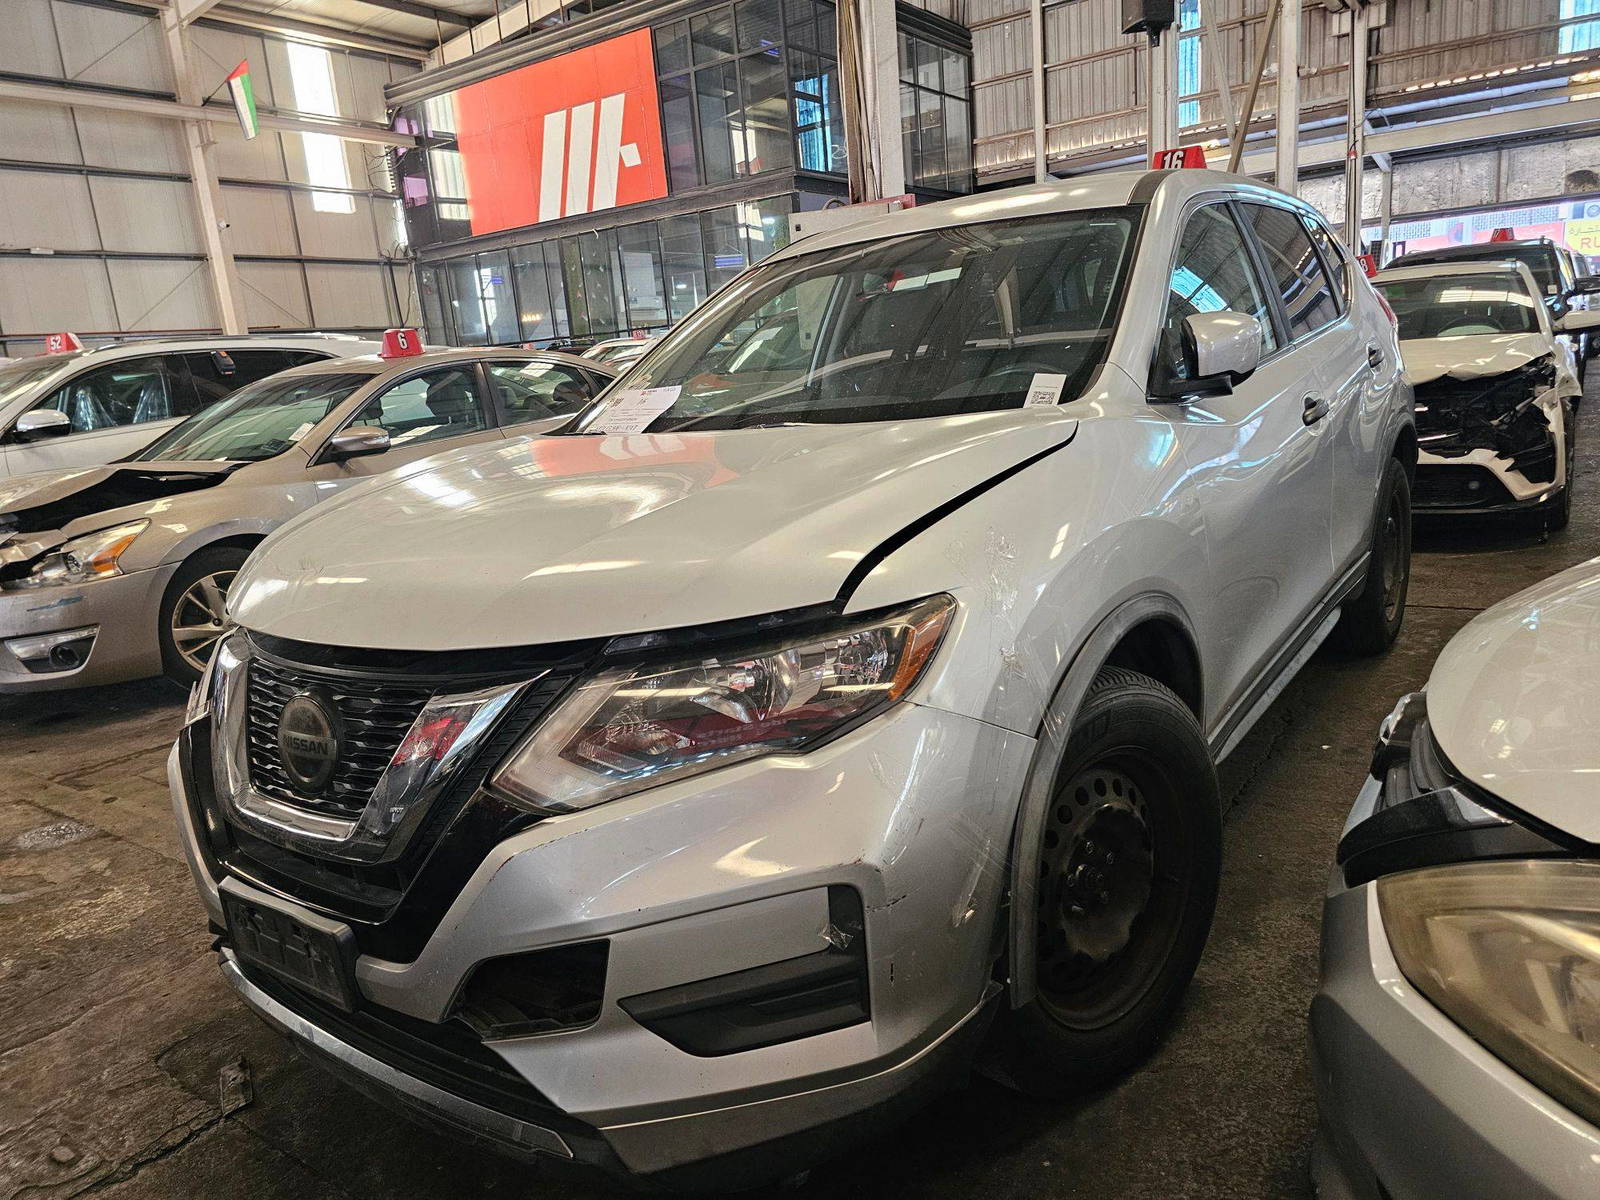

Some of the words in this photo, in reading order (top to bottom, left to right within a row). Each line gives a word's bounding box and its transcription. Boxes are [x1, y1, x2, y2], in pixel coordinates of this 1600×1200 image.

[1163, 151, 1184, 169] 16
[50, 335, 62, 350] 52
[397, 332, 408, 350] 6
[284, 735, 328, 755] NISSAN
